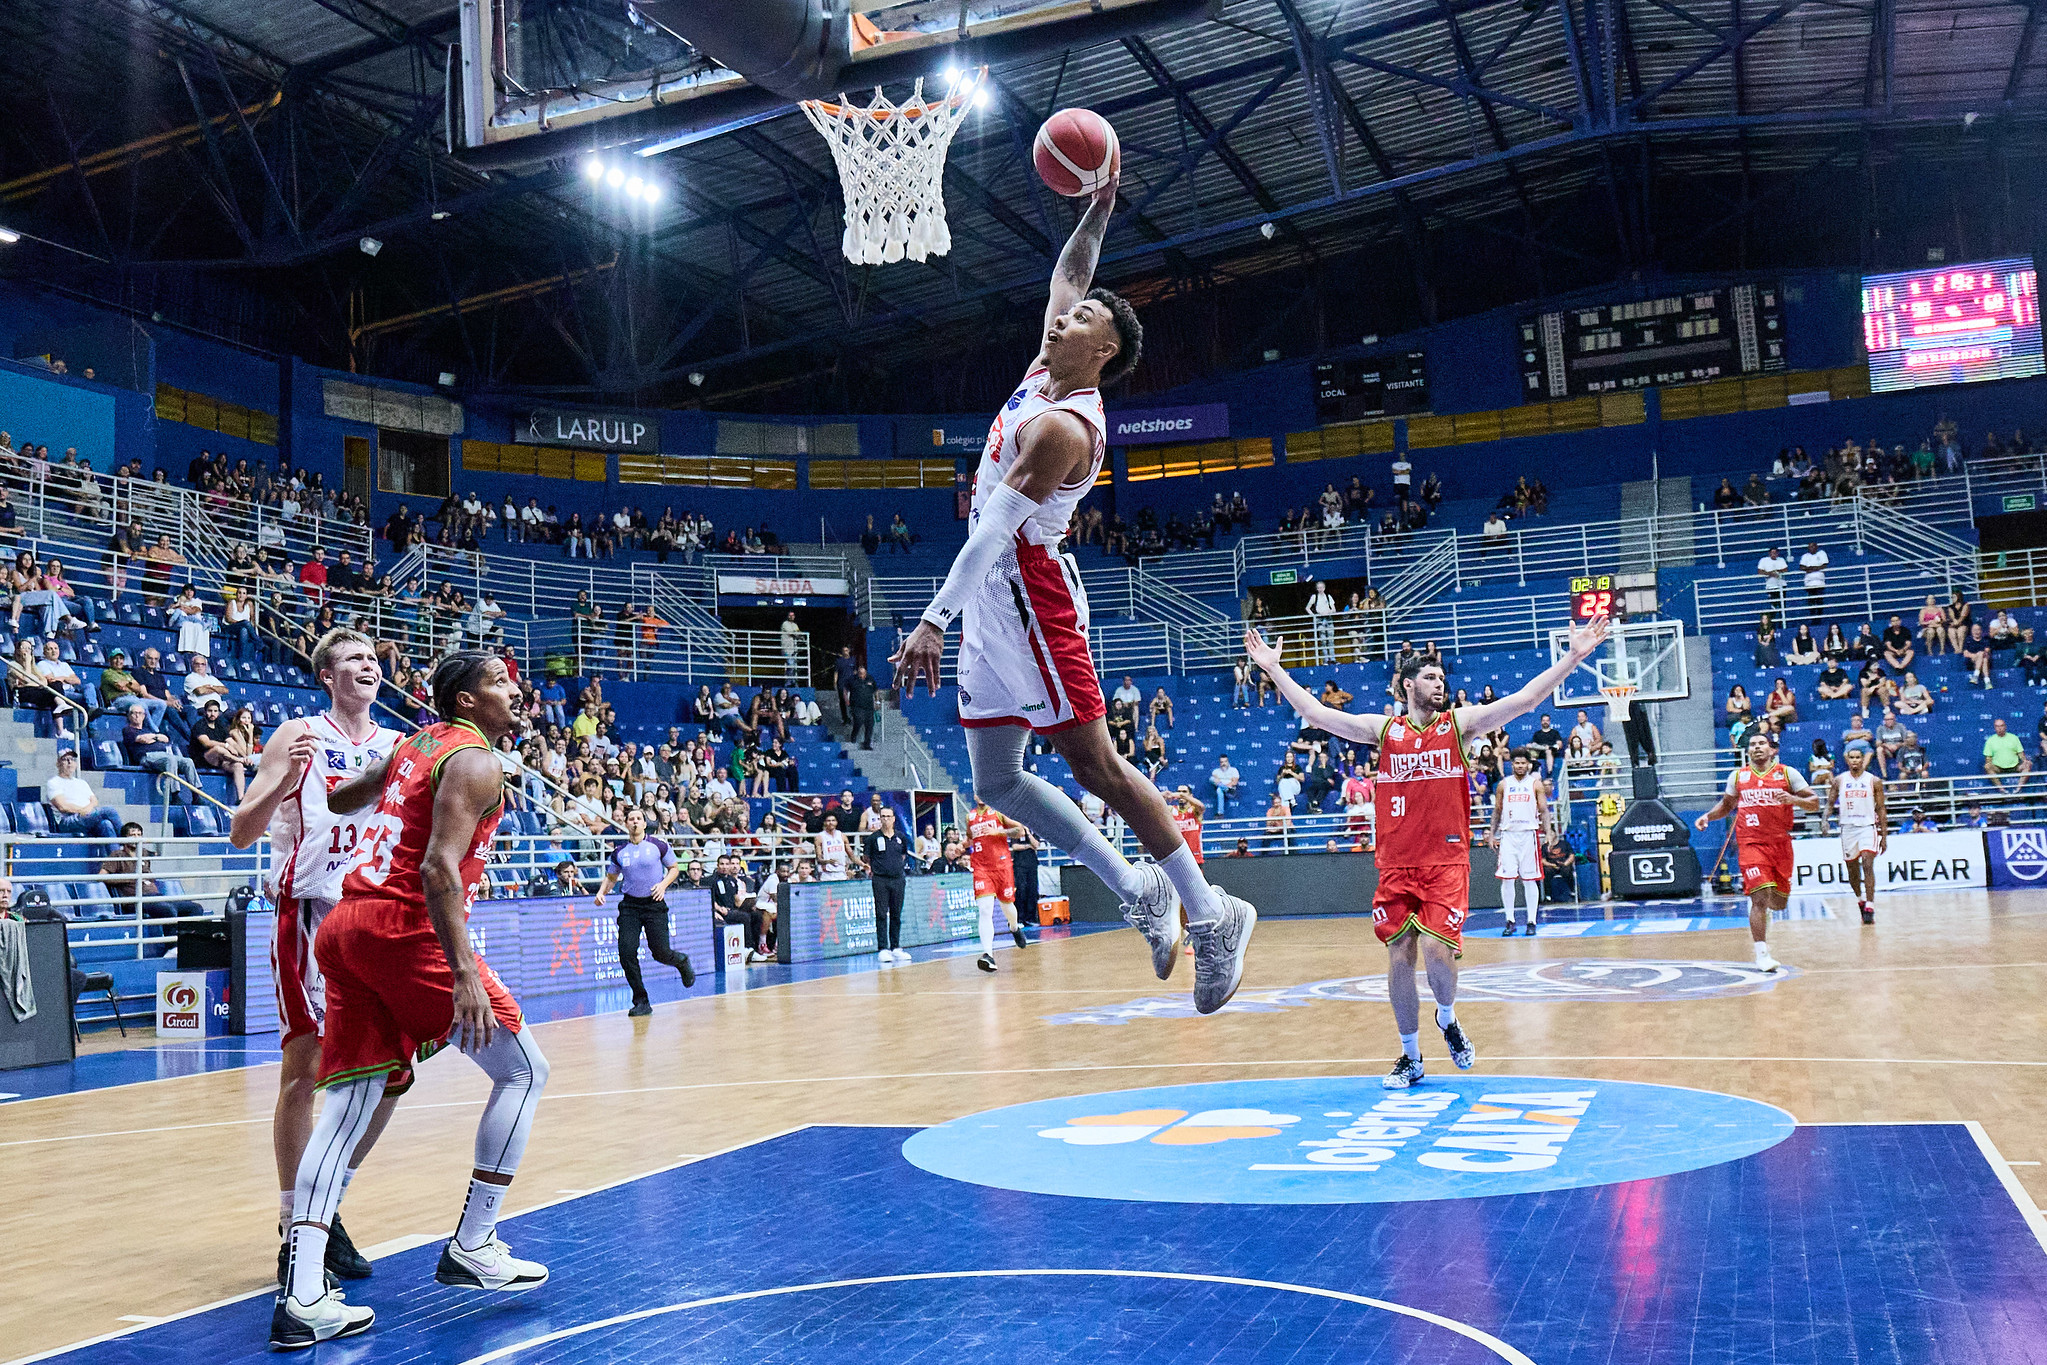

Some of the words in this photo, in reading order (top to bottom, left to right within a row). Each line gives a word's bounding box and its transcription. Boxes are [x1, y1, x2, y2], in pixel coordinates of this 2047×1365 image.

[1386, 379, 1424, 390] VISITANTE
[1321, 389, 1346, 398] LOCAL
[557, 416, 645, 445] LARULP
[976, 435, 988, 445] pi
[1571, 576, 1611, 592] 02:19
[1580, 592, 1611, 617] 22
[1391, 796, 1405, 817] 31
[1745, 813, 1760, 827] 29
[1624, 824, 1674, 835] INGRESSOS
[328, 823, 358, 854] 13
[1633, 833, 1666, 842] ONLINE
[15, 848, 21, 858] 3
[56, 848, 63, 857] 2
[1797, 862, 1867, 886] POL
[1888, 858, 1970, 882] WEAR
[844, 896, 876, 920] UNIF
[166, 1014, 197, 1028] Graal
[1416, 1090, 1598, 1173] CAIXA
